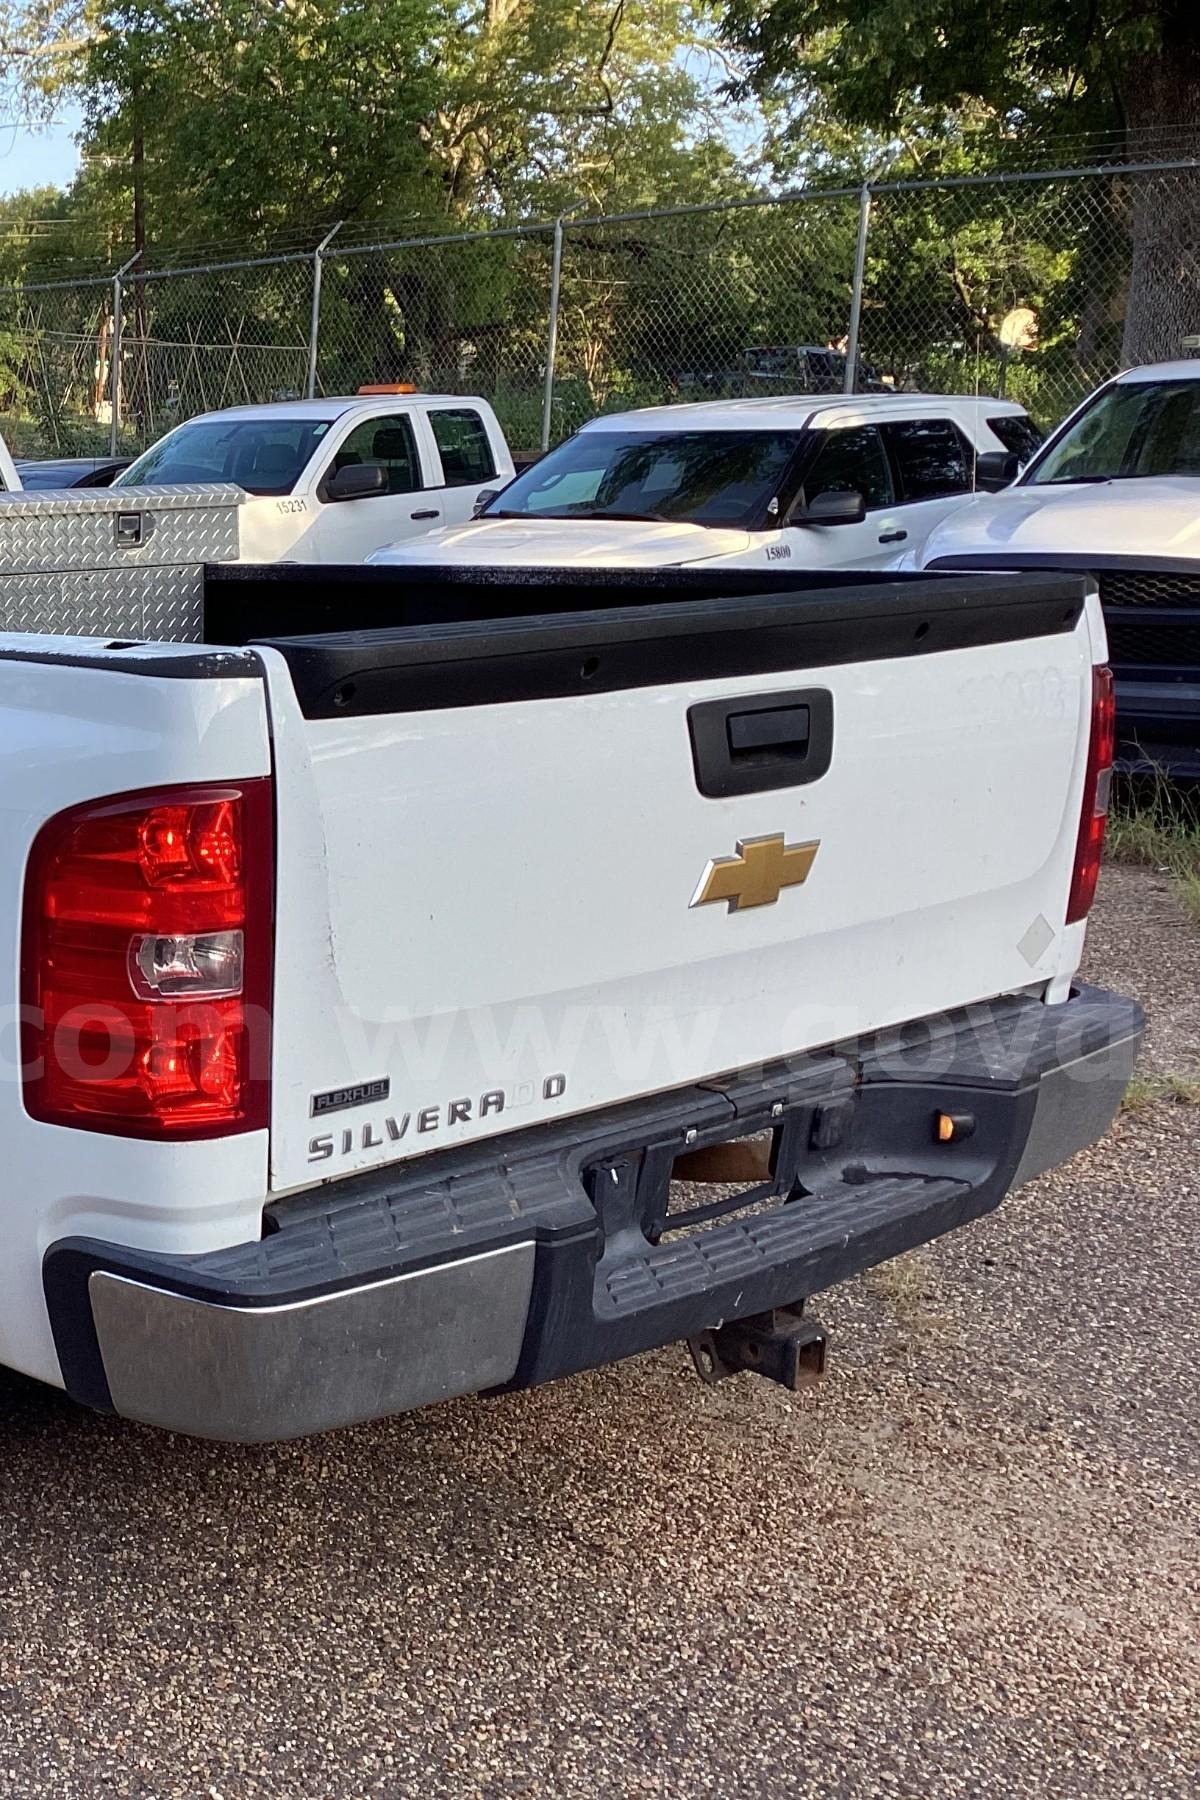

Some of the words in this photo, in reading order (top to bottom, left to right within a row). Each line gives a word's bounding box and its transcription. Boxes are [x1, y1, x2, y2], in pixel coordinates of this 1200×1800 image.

[275, 499, 308, 515] 15231
[765, 545, 792, 560] 15800
[316, 1083, 389, 1107] FLEXFUEL
